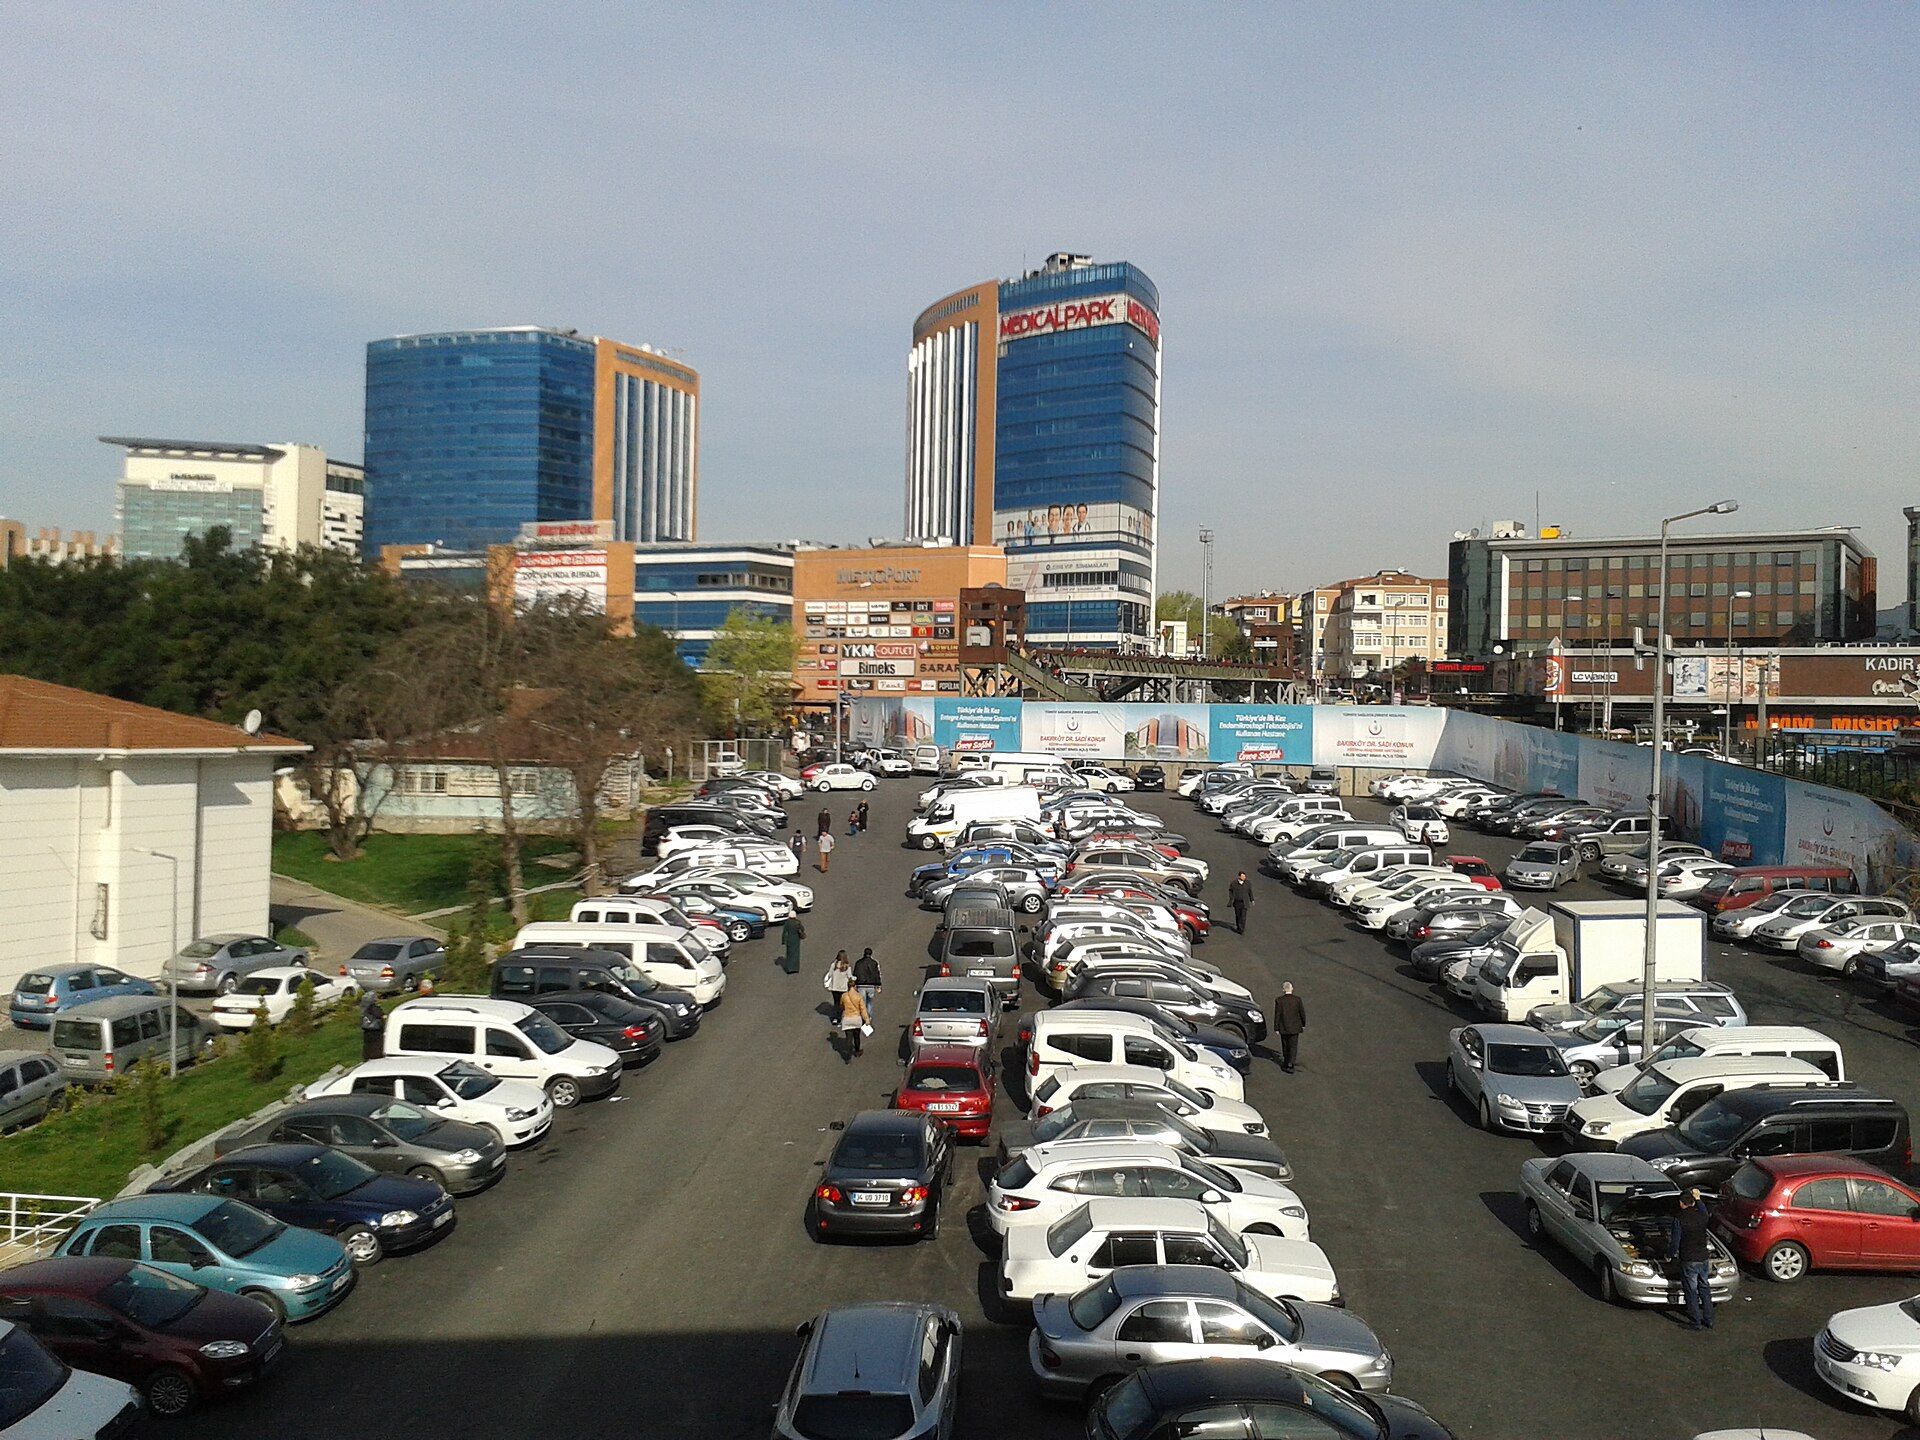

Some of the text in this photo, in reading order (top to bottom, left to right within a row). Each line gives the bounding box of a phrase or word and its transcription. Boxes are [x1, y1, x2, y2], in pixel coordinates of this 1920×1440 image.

[1000, 298, 1115, 337] MEDICAL PARK
[842, 644, 875, 657] YKM
[881, 646, 913, 655] OUTLET
[859, 661, 896, 675] Bimeks
[1236, 714, 1267, 723] Türkiye'de
[1238, 749, 1282, 761] Önce Sağlık
